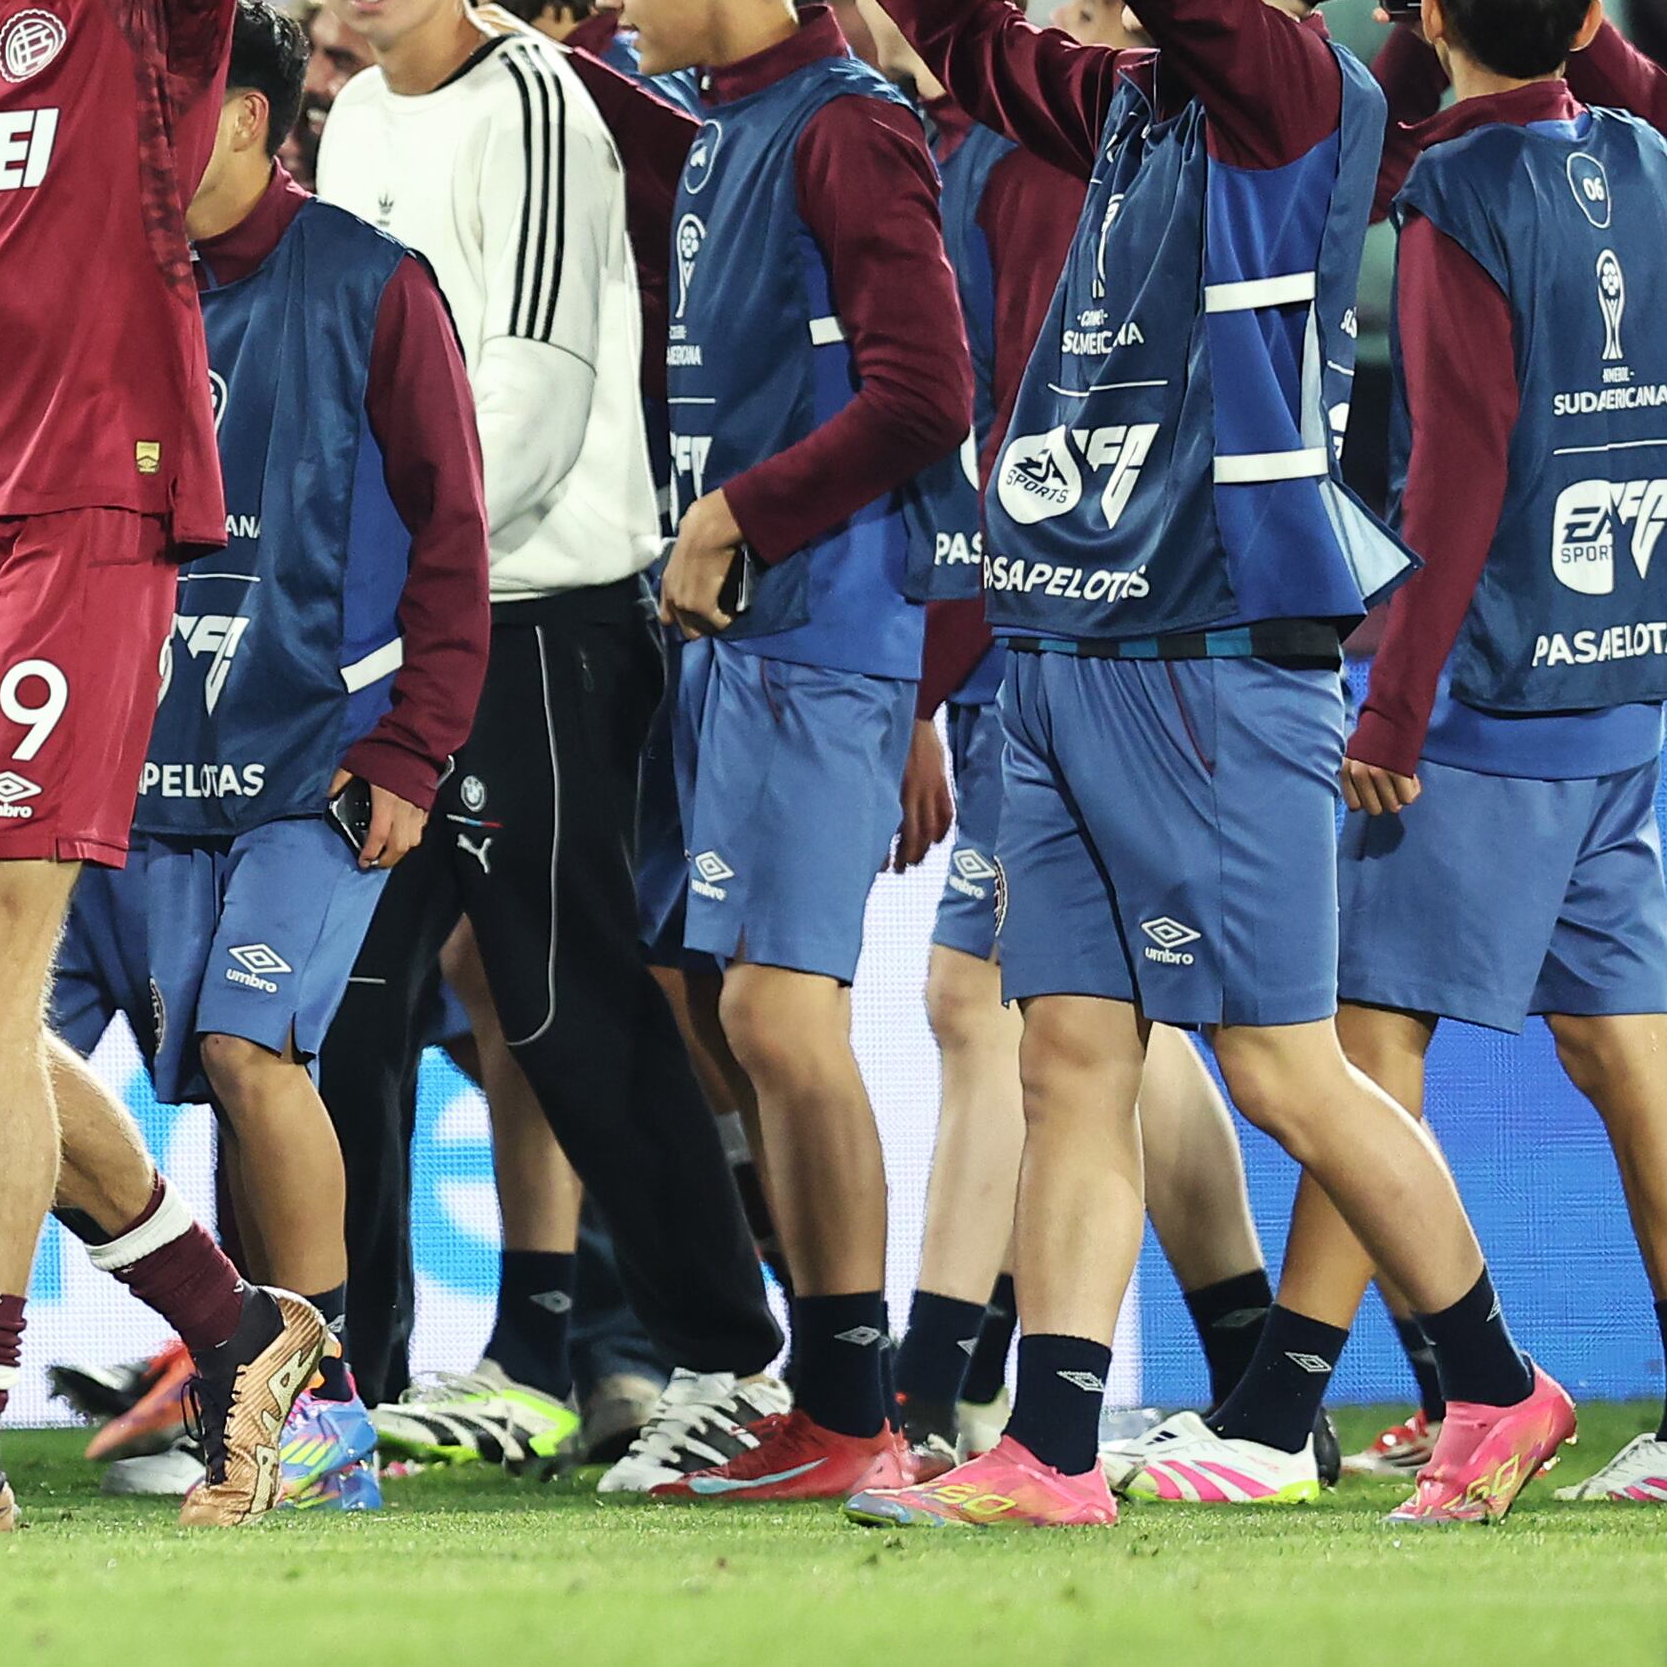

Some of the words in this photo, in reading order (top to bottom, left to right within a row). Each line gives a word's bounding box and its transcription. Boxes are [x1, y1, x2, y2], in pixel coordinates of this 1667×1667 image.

[1006, 469, 1069, 505] SPORTS
[139, 763, 266, 798] PELOTAS
[1145, 946, 1195, 966] umbro
[226, 969, 277, 993] umbro
